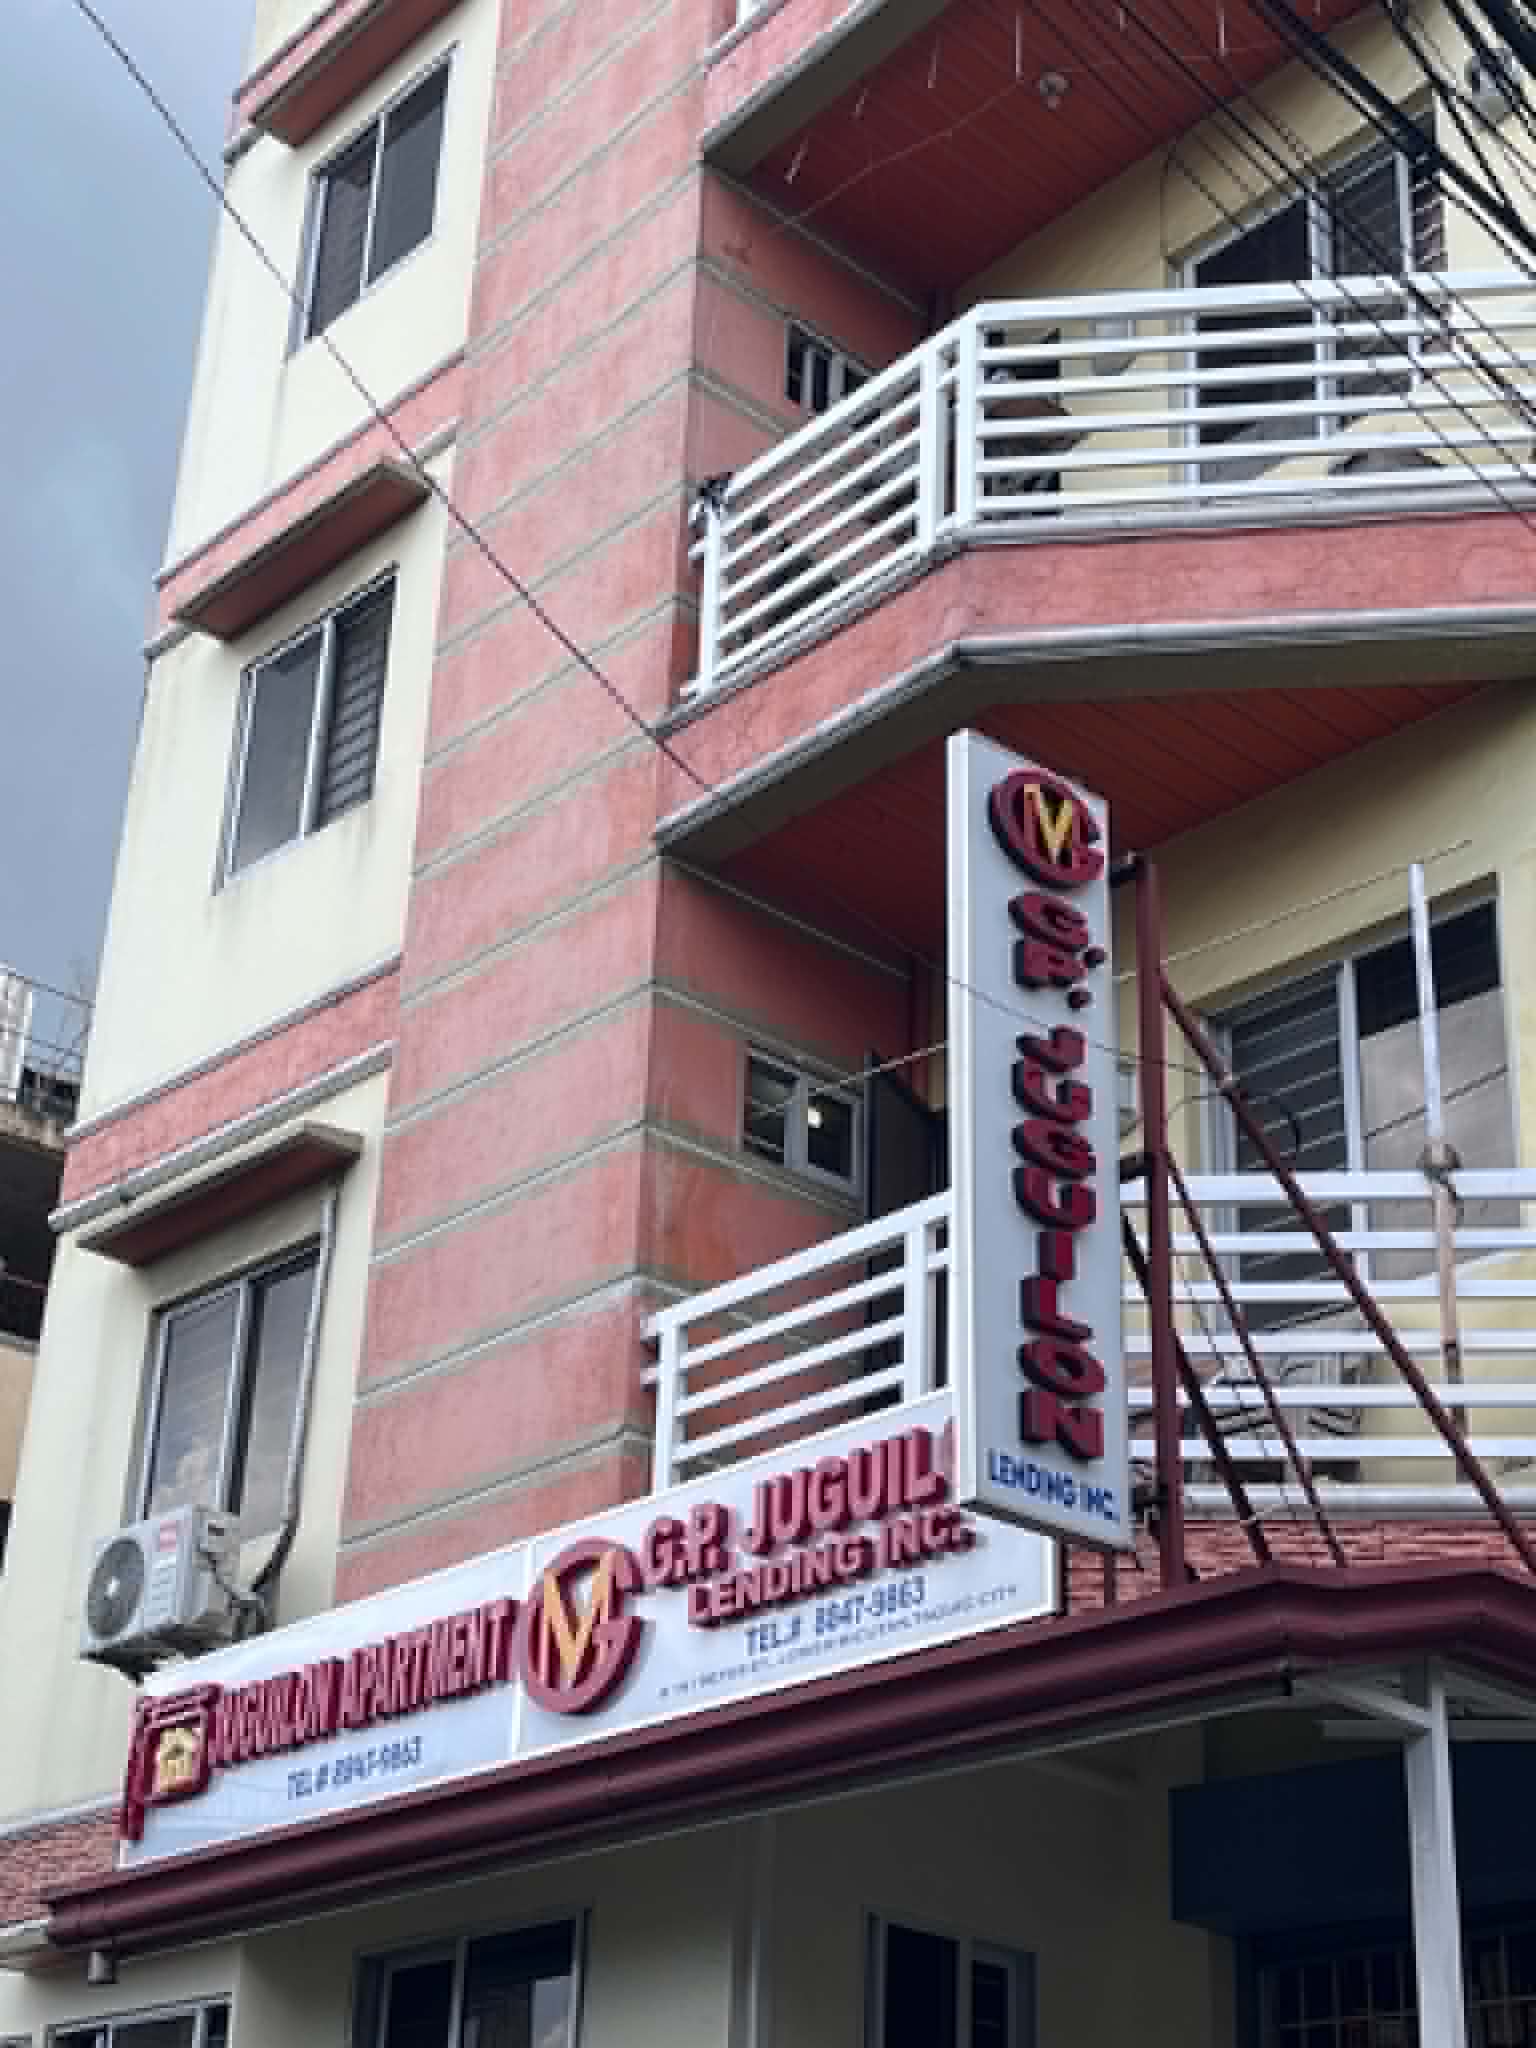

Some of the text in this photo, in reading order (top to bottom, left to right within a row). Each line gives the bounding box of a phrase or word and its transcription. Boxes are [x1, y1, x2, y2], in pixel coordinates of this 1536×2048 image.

[1010, 1025, 1107, 1462] JUGUILON
[640, 1417, 958, 1586] G.P. JUGUIL
[986, 1446, 1077, 1508] LENDING
[687, 1540, 874, 1628] LENDING
[206, 1597, 518, 1768] JUGUILON APARTMENT
